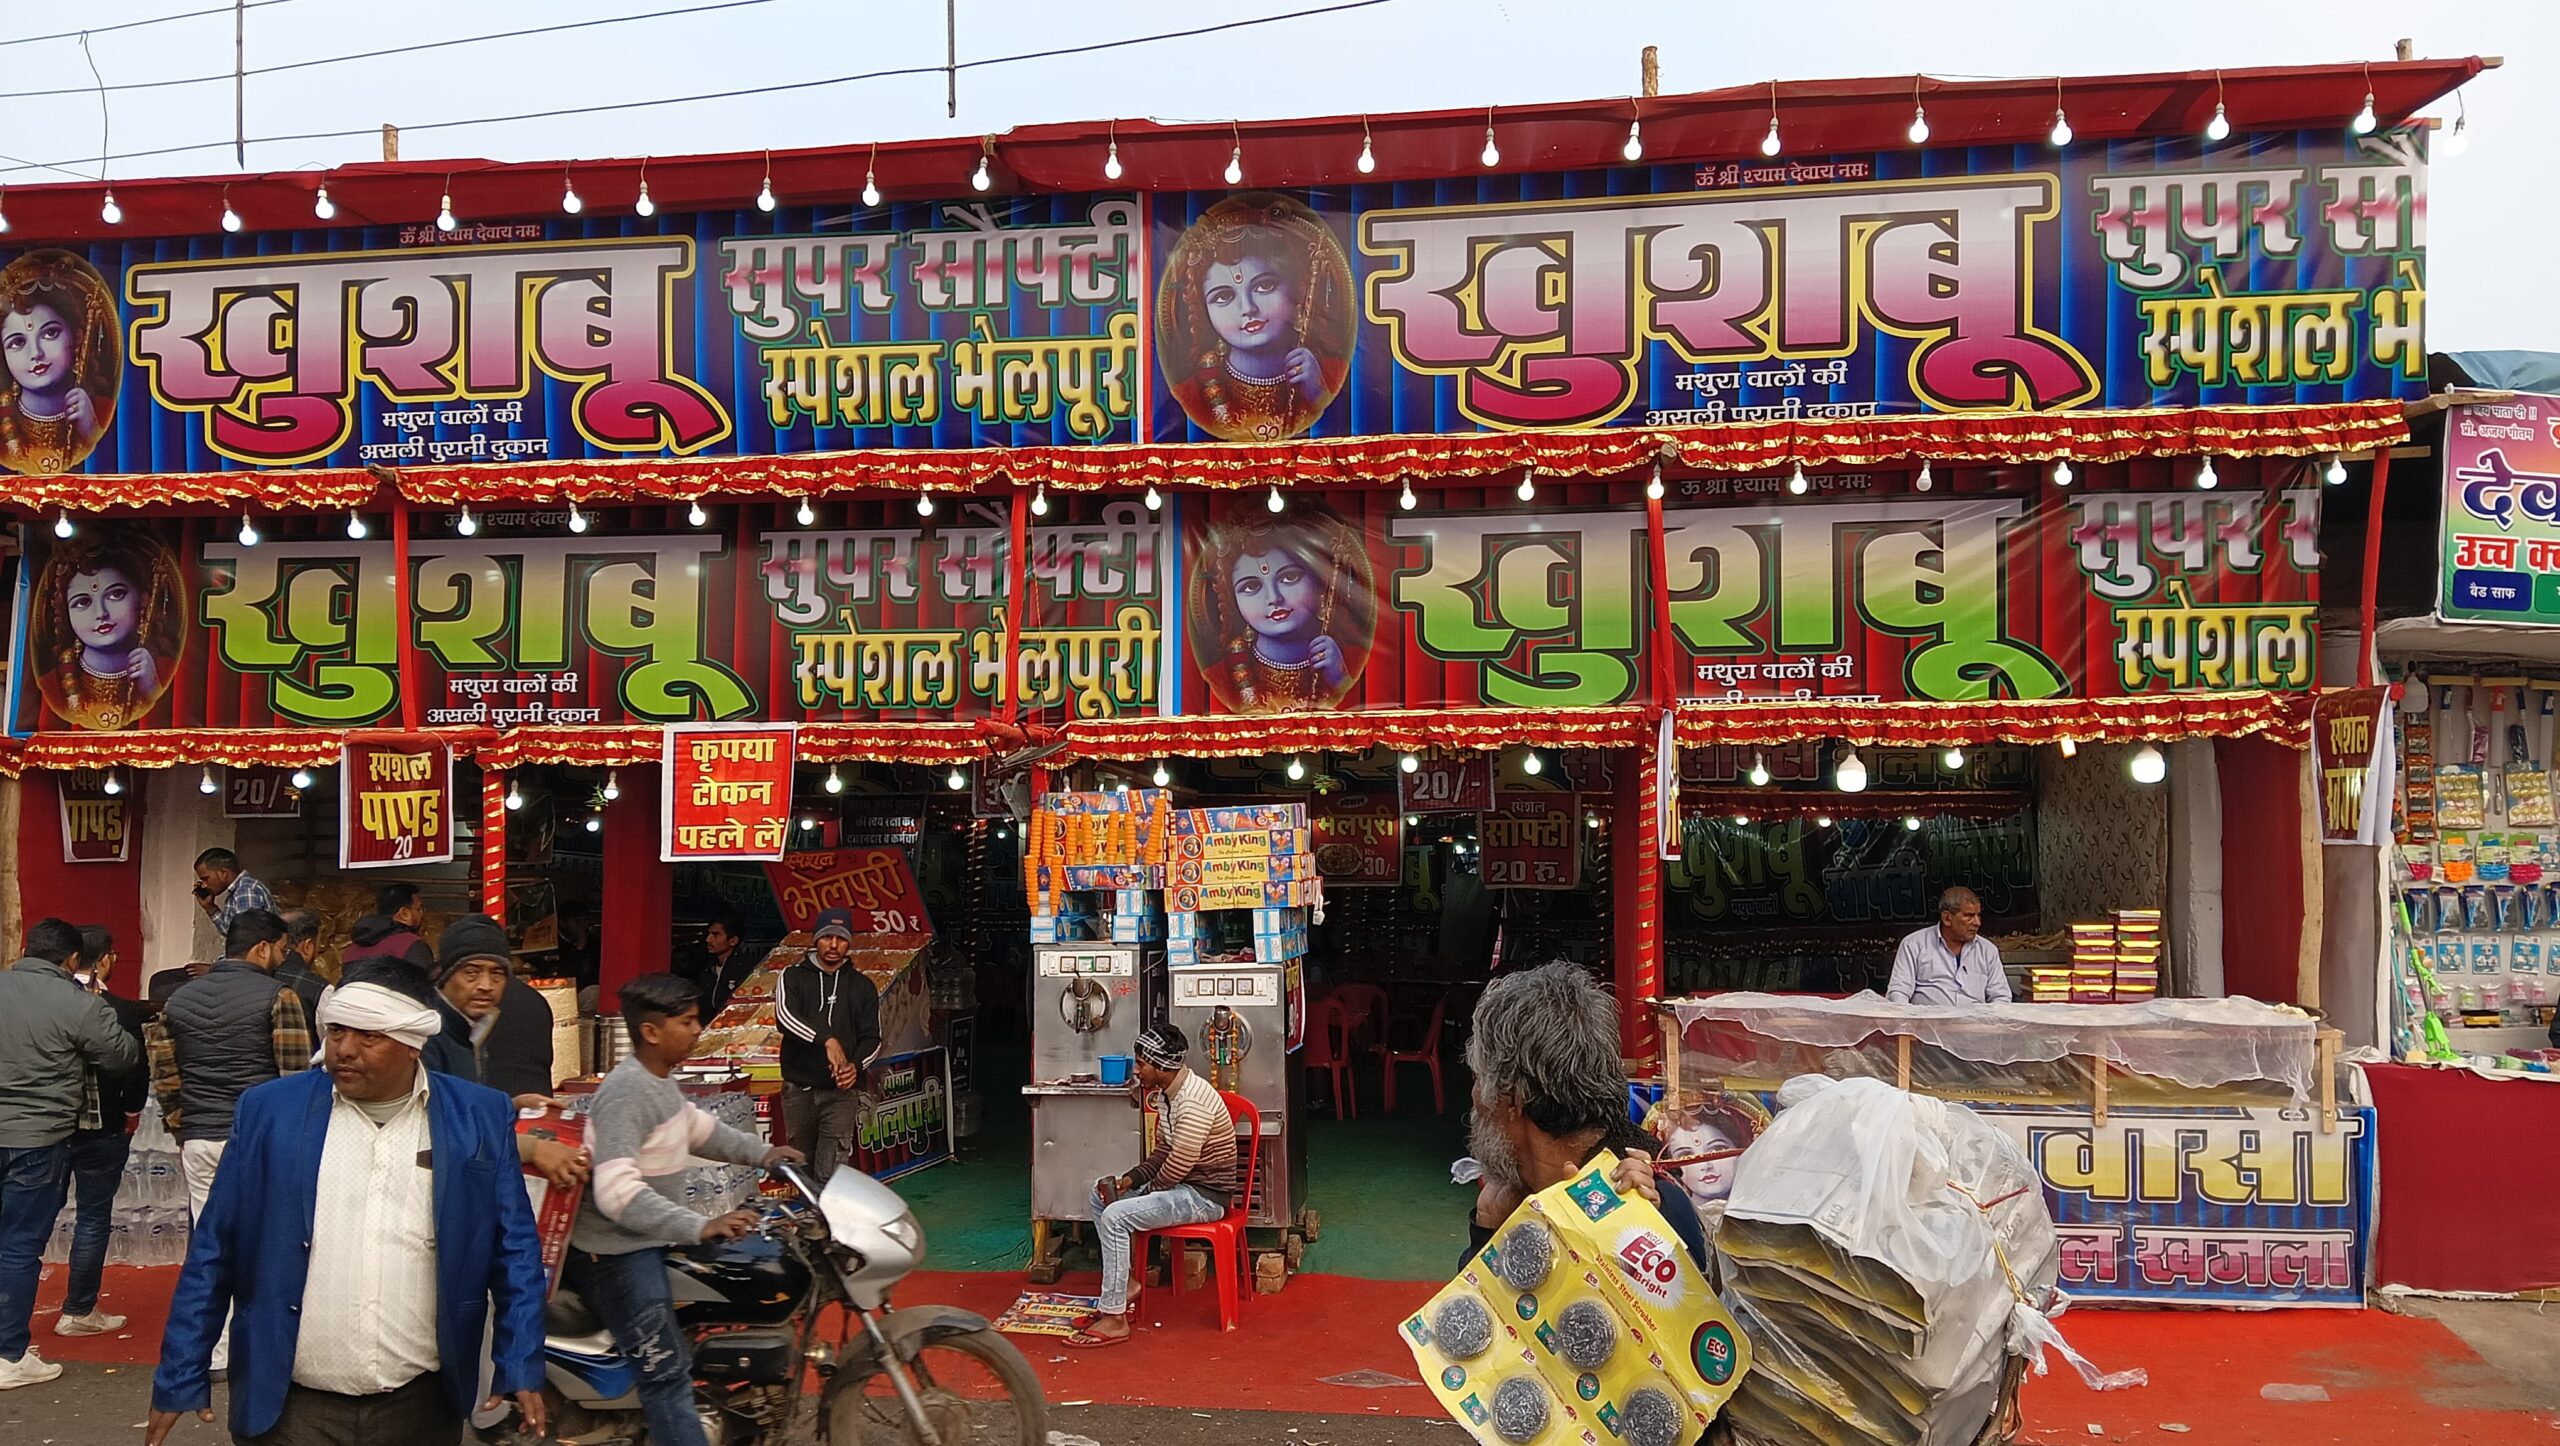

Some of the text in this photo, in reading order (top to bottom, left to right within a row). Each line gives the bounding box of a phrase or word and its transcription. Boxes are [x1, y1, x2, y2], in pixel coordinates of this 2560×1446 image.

[1717, 164, 1741, 186] श्री
[1744, 167, 1787, 184] श्याम
[1790, 161, 1836, 183] देवाय
[417, 225, 435, 243] श्री
[476, 222, 512, 241] देवाय
[2092, 168, 2305, 288] सुपर
[723, 235, 901, 336] सुपर
[1364, 175, 2098, 426] खुशबू
[2143, 265, 2361, 385] स्पेशल
[131, 241, 729, 463] खुशबू
[762, 315, 1138, 440] स्पेशल भेलपूरी
[1674, 358, 1848, 399] मथुरा वालों की
[381, 401, 523, 436] मथुरा वालों की
[1645, 400, 1726, 426] असली
[2473, 404, 2490, 416] जय
[2492, 405, 2513, 418] माता
[2514, 404, 2526, 419] दी
[359, 433, 549, 461] असली पुरानी दुकान
[2478, 424, 2506, 439] अजय
[1732, 477, 1781, 494] श्याम
[487, 511, 527, 527] श्याम
[2069, 489, 2265, 598] सुपर
[2454, 534, 2519, 570] उच्च
[760, 528, 921, 624] सुपर
[1390, 499, 2073, 706] खुशबू
[2490, 587, 2516, 599] साफ
[203, 533, 757, 723] खुशबू
[2116, 580, 2319, 688] स्पेशल
[794, 608, 962, 708] स्पेशल
[1697, 654, 1854, 687] मथुरा वालों की
[450, 671, 578, 701] मथुरा वालों की
[426, 703, 601, 728] असली पुरानी दुकान
[690, 737, 777, 773] कृपया
[690, 776, 775, 807] टोकन
[677, 816, 786, 850] पहले लें
[1205, 833, 1267, 847] Amby King
[1317, 804, 1395, 846] भेलपूरी
[392, 834, 413, 859] 20
[1203, 859, 1266, 874] Amby King
[1491, 859, 1528, 883] 20
[1200, 885, 1262, 900] Amby King
[868, 909, 906, 933] 30
[1620, 1235, 1677, 1283] ECO
[1595, 1254, 1619, 1285] Stainless
[1618, 1283, 1635, 1303] Steel
[1631, 1300, 1658, 1332] Scrubber
[1632, 1269, 1669, 1299] Bright
[1030, 1304, 1066, 1313] Amby
[1707, 1338, 1727, 1355] ECO
